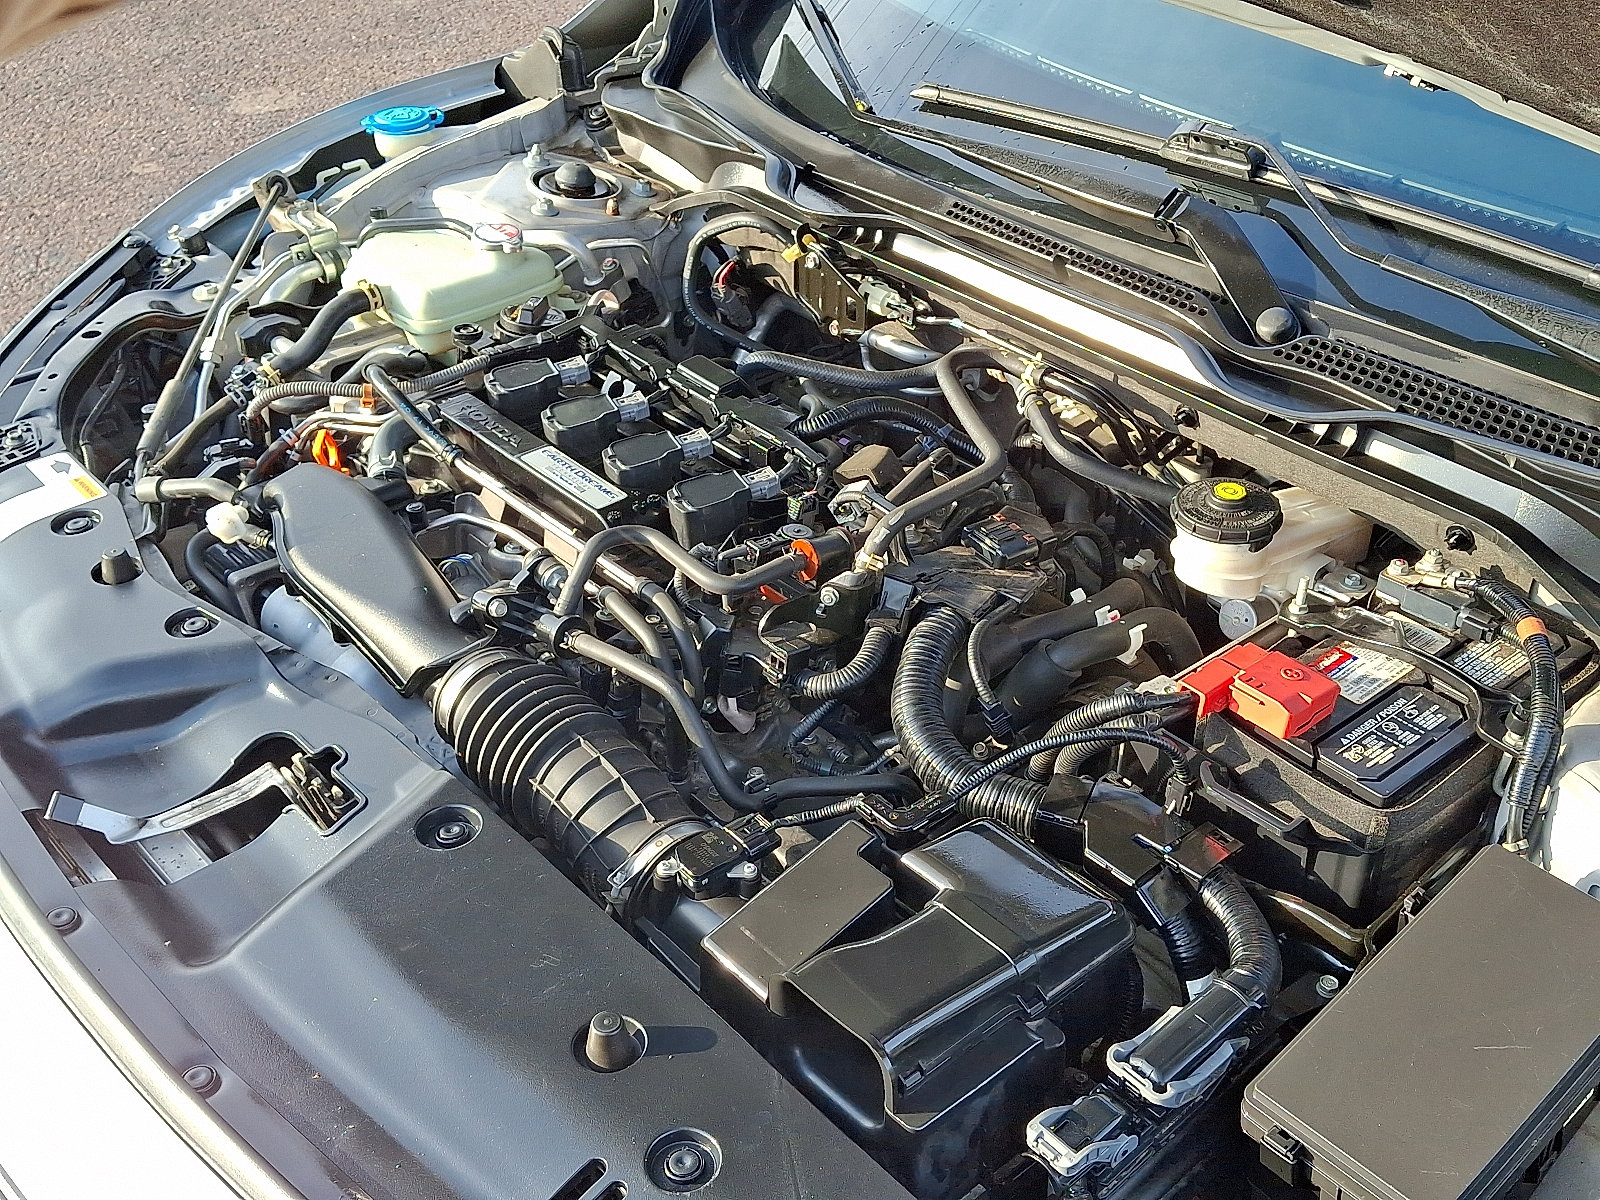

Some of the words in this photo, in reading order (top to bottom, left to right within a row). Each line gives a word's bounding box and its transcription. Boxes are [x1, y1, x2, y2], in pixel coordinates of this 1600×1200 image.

[454, 404, 523, 448] HONDA
[541, 448, 577, 472] EARTH
[574, 469, 619, 499] DREAMS
[1346, 718, 1379, 740] DANGER
[1379, 697, 1409, 718] POISON
